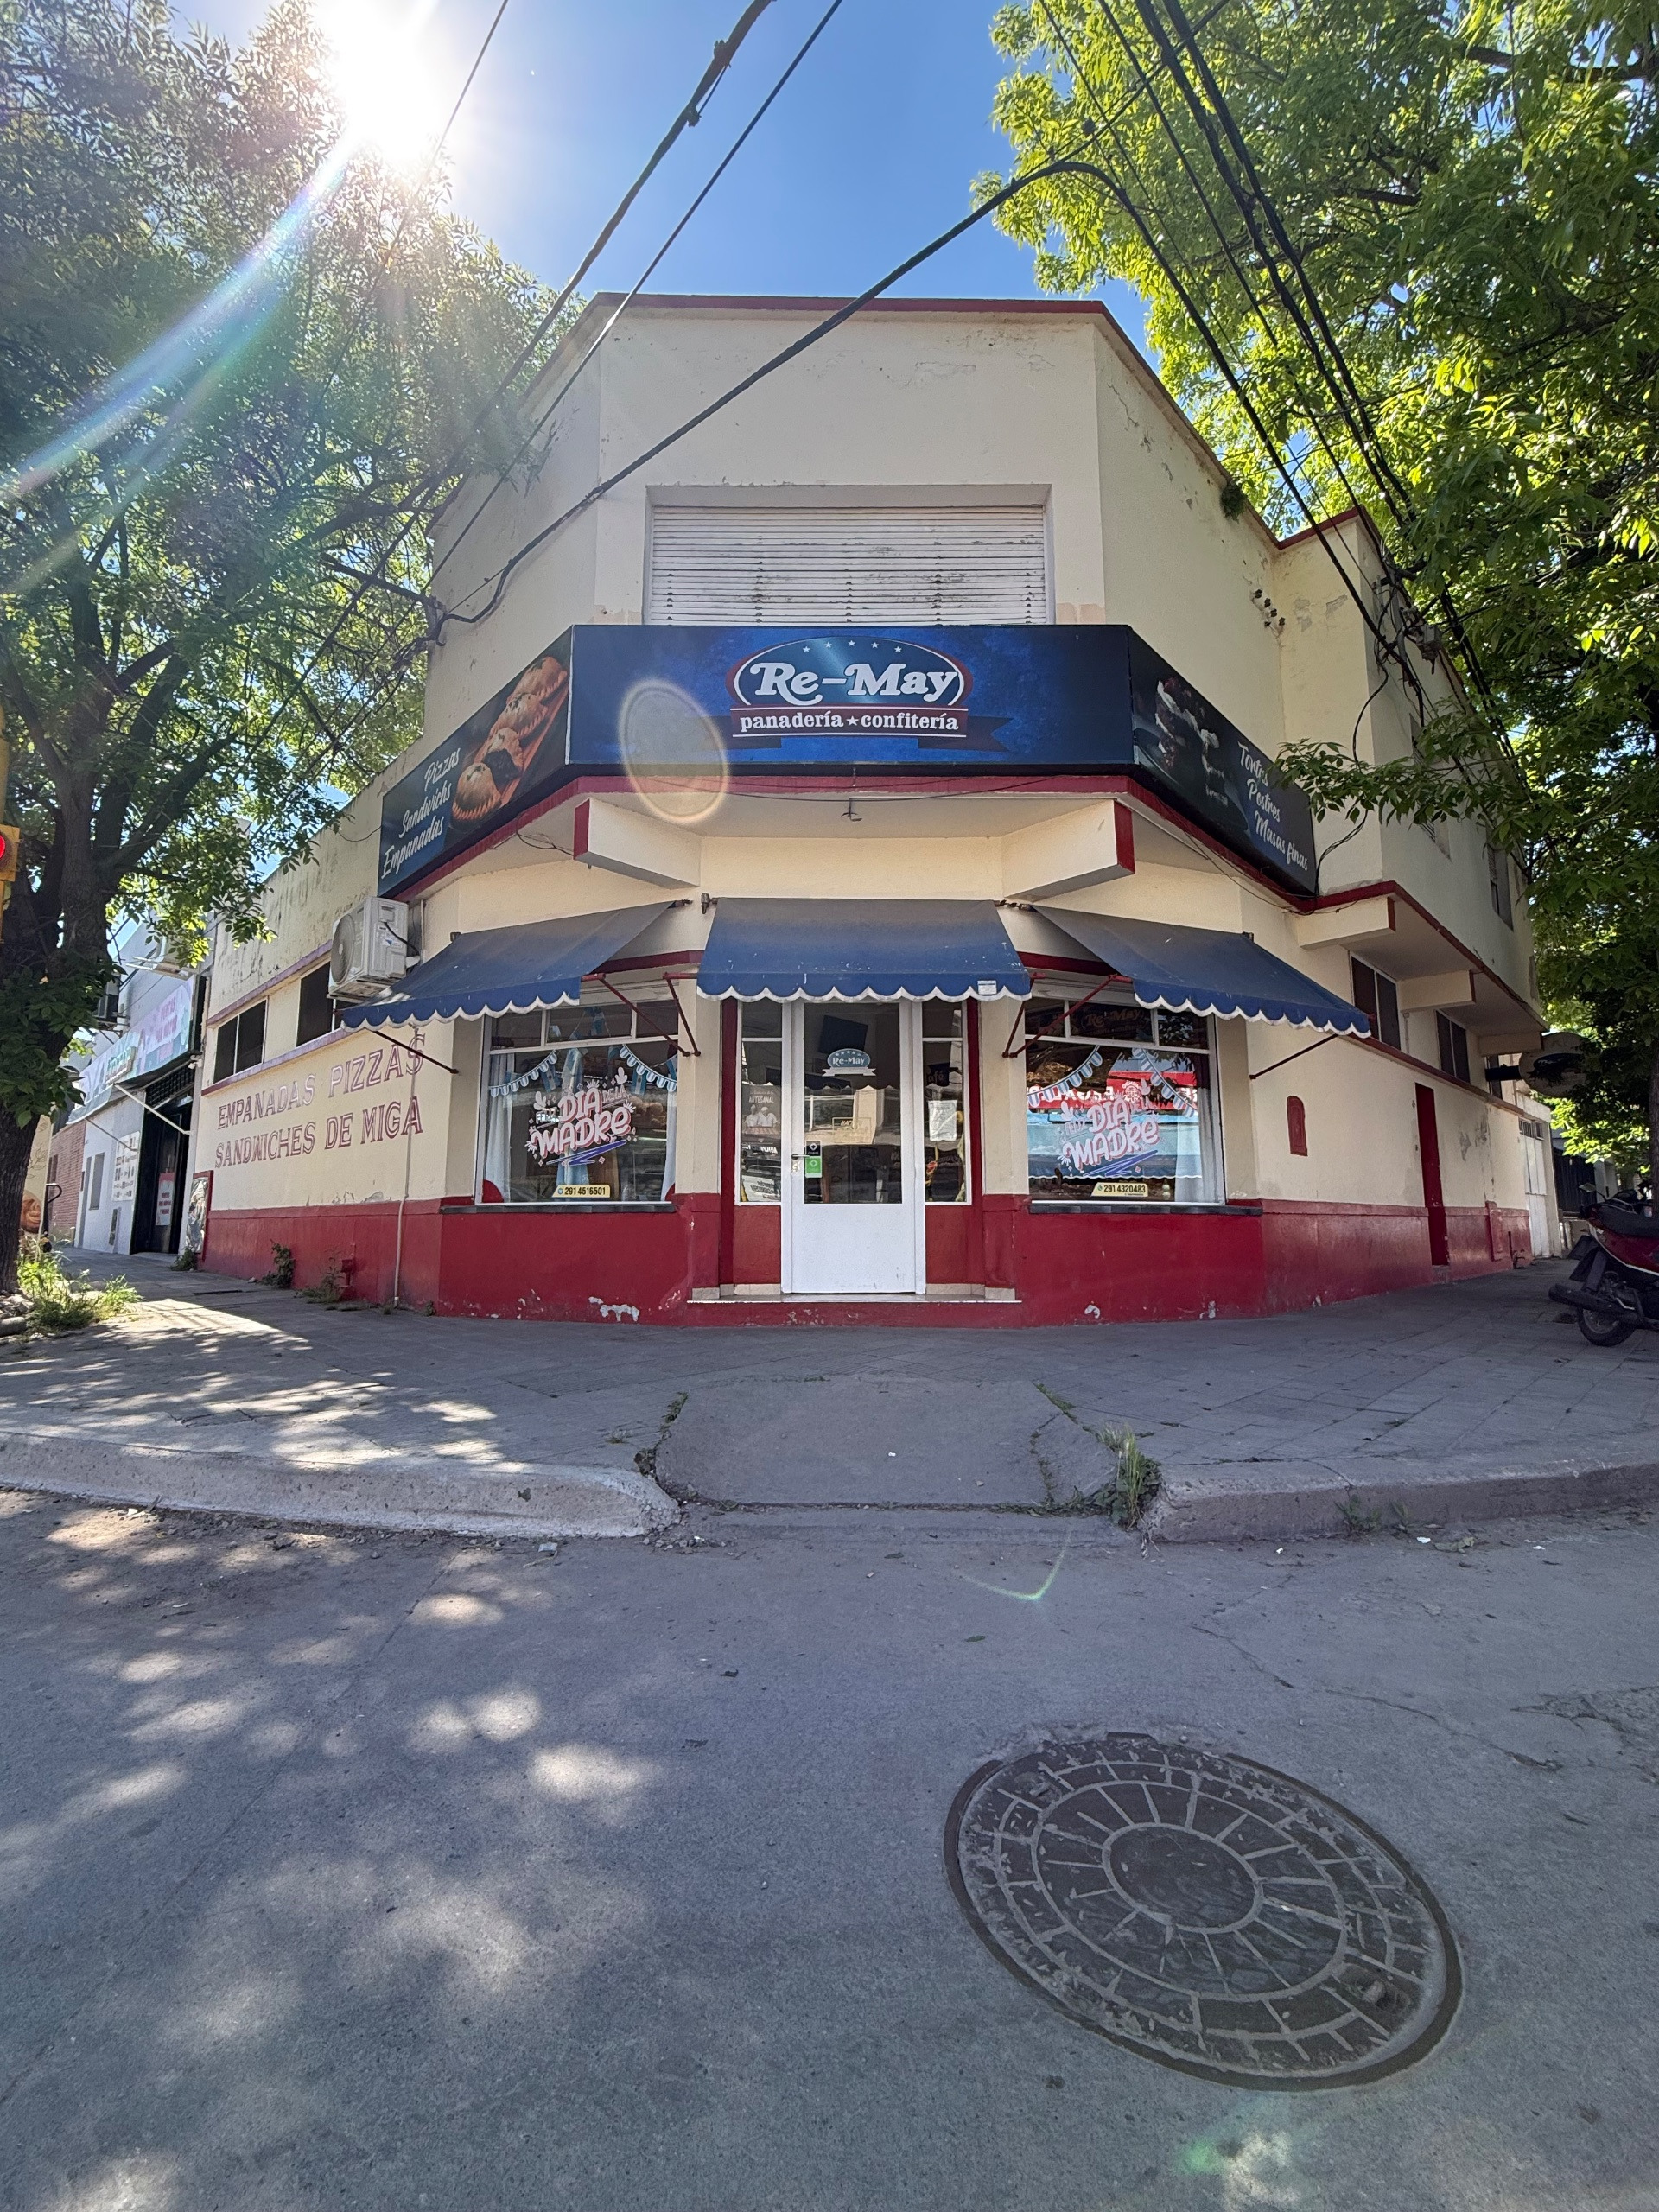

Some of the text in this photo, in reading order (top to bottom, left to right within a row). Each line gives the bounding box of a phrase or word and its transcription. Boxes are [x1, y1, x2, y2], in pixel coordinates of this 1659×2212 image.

[750, 663, 958, 706] Re-May
[741, 711, 960, 733] panadería confitería
[424, 747, 461, 792] Pizzas
[398, 779, 452, 839] Sandwichs
[1247, 779, 1281, 823] Postres
[381, 815, 445, 880] Empanadas
[1255, 810, 1308, 872] Masas finas
[218, 1033, 426, 1130] EMPANADAS PIZZAS
[832, 1057, 865, 1067] Re-May
[557, 1087, 602, 1123] DIA
[1087, 1097, 1131, 1134] DIA
[215, 1096, 423, 1168] SANDWICHES DE MIGA
[530, 1107, 632, 1159] MADRE
[1062, 1117, 1160, 1171] MADRE
[564, 1186, 606, 1195] 291 4516501
[1103, 1185, 1146, 1193] 291 4320483
